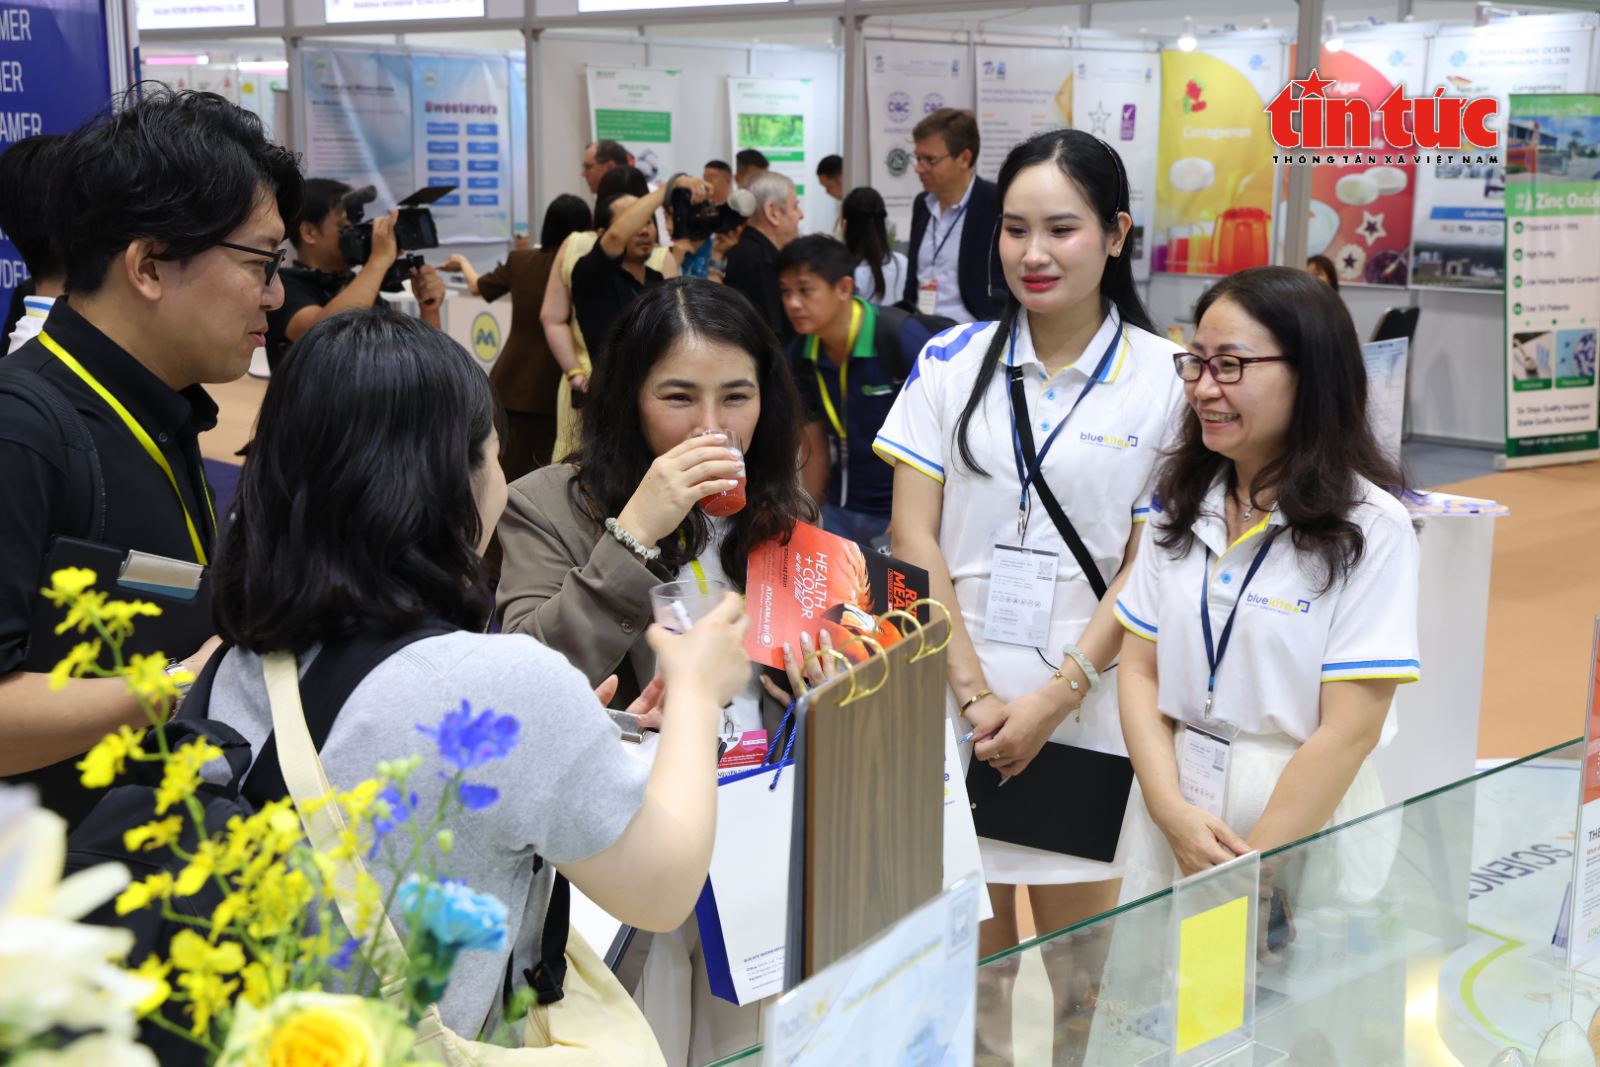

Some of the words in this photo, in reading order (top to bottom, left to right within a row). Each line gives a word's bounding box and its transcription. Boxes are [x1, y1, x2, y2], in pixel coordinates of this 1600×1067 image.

[425, 101, 498, 115] Sweeteners
[801, 567, 815, 620] COLOR
[815, 551, 828, 609] HEALTH
[894, 570, 906, 611] MEA
